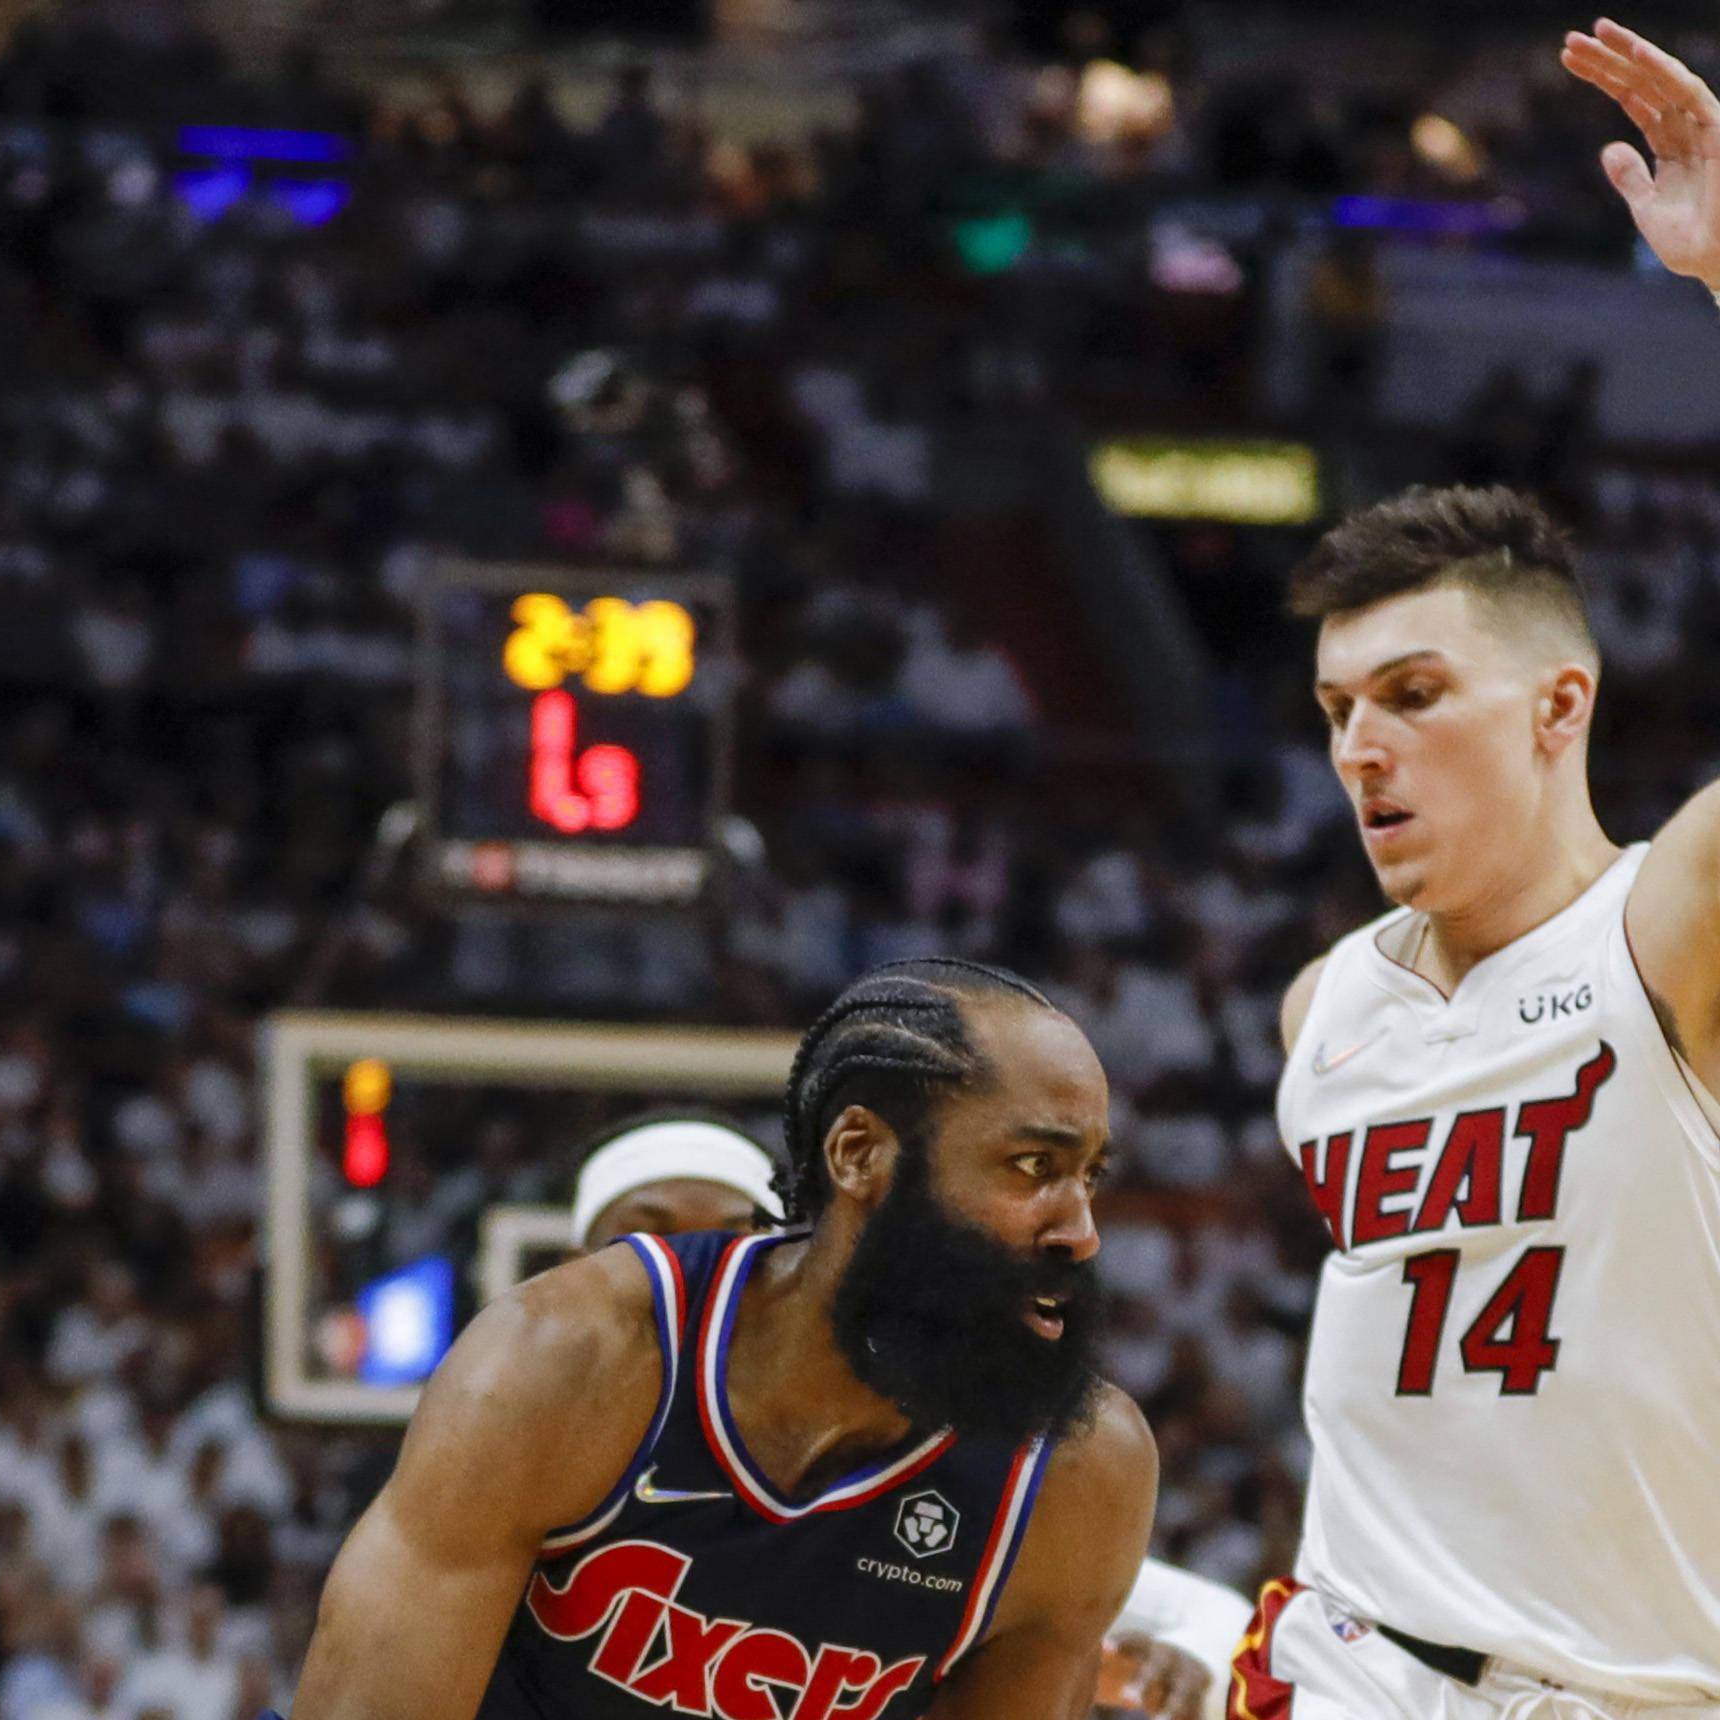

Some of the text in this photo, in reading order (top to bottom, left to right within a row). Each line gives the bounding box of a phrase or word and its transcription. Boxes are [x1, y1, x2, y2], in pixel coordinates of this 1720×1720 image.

[1519, 984, 1592, 1024] UKG
[1299, 1039, 1617, 1254] HEAT
[1395, 1245, 1566, 1397] 14
[857, 1555, 963, 1593] crypto.com
